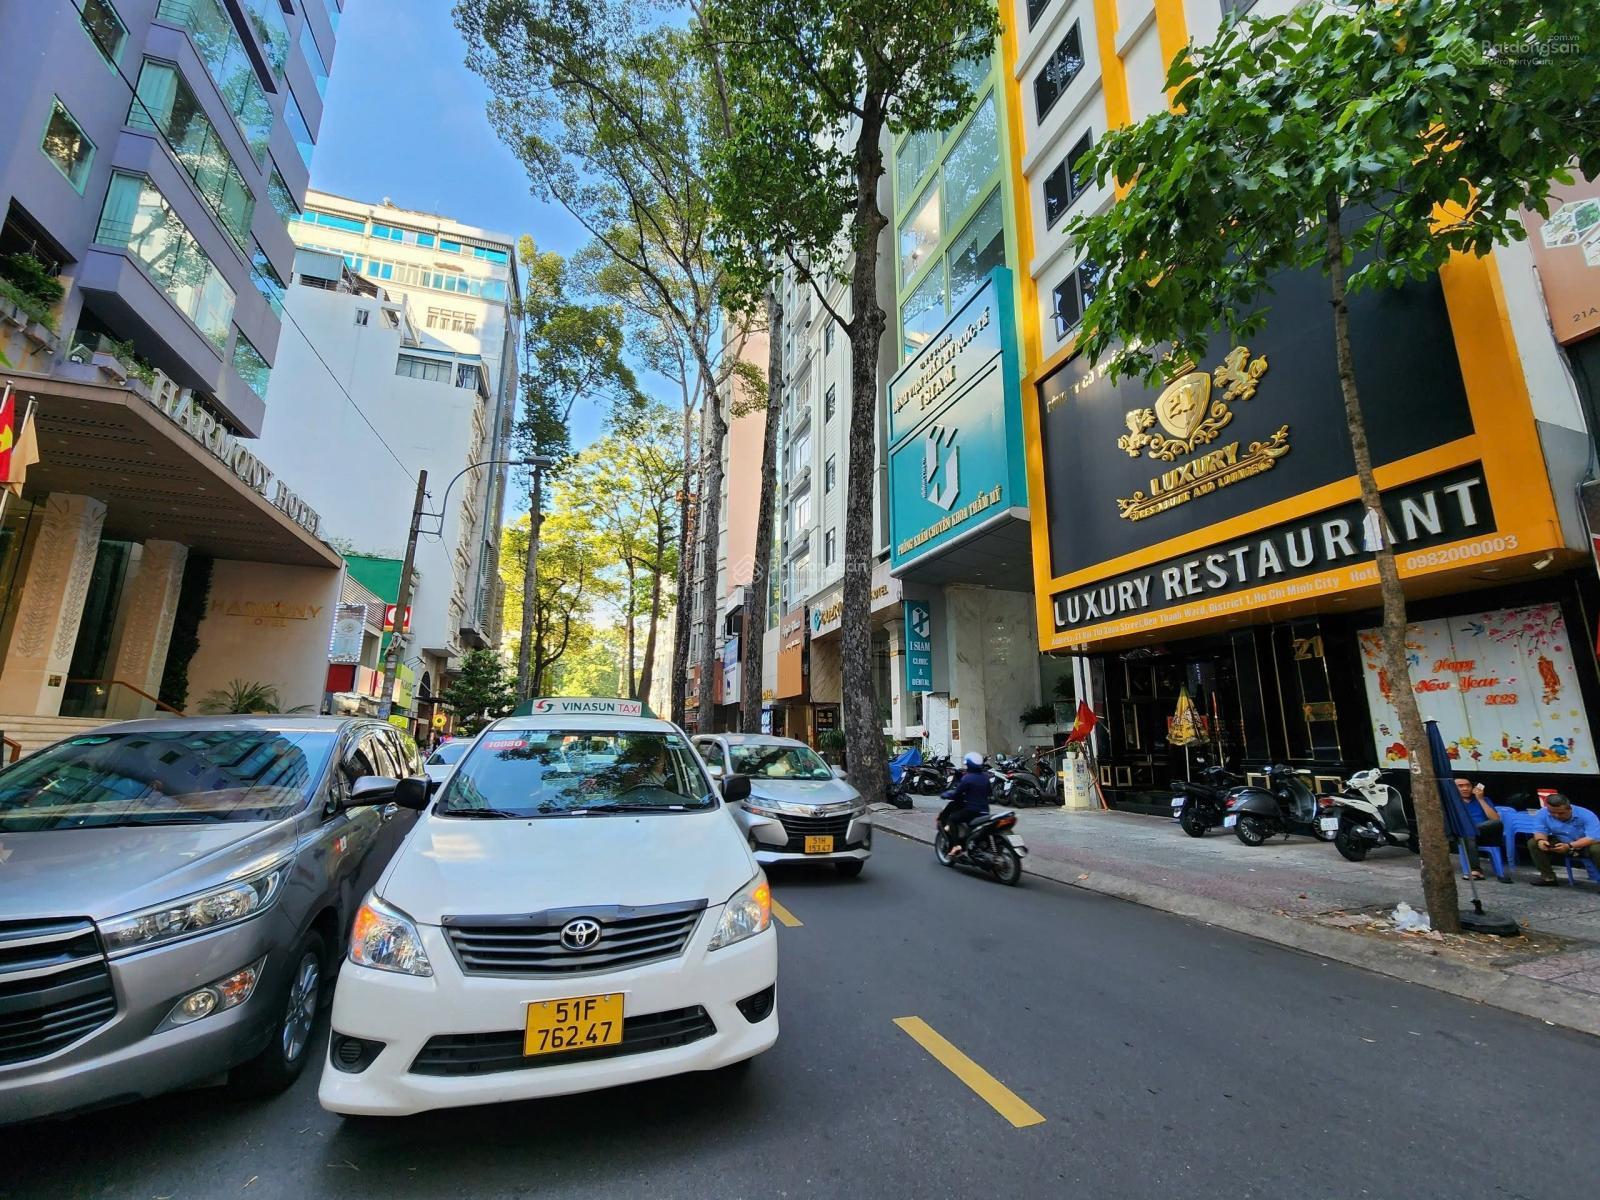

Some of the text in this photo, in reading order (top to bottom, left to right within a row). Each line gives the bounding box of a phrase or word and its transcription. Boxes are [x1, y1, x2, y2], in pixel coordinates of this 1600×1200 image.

[150, 367, 322, 539] HARMONY HOTEL
[1150, 441, 1239, 497] LUXURY
[1193, 481, 1216, 498] AND
[1054, 478, 1481, 627] LUXURY RESTAURNT
[1314, 576, 1340, 591] City
[1432, 658, 1477, 674] Happy
[1415, 675, 1500, 694] New Year
[562, 702, 640, 714] VINASUN TAXI
[556, 999, 597, 1023] 51F
[538, 1021, 613, 1051] 762.47
